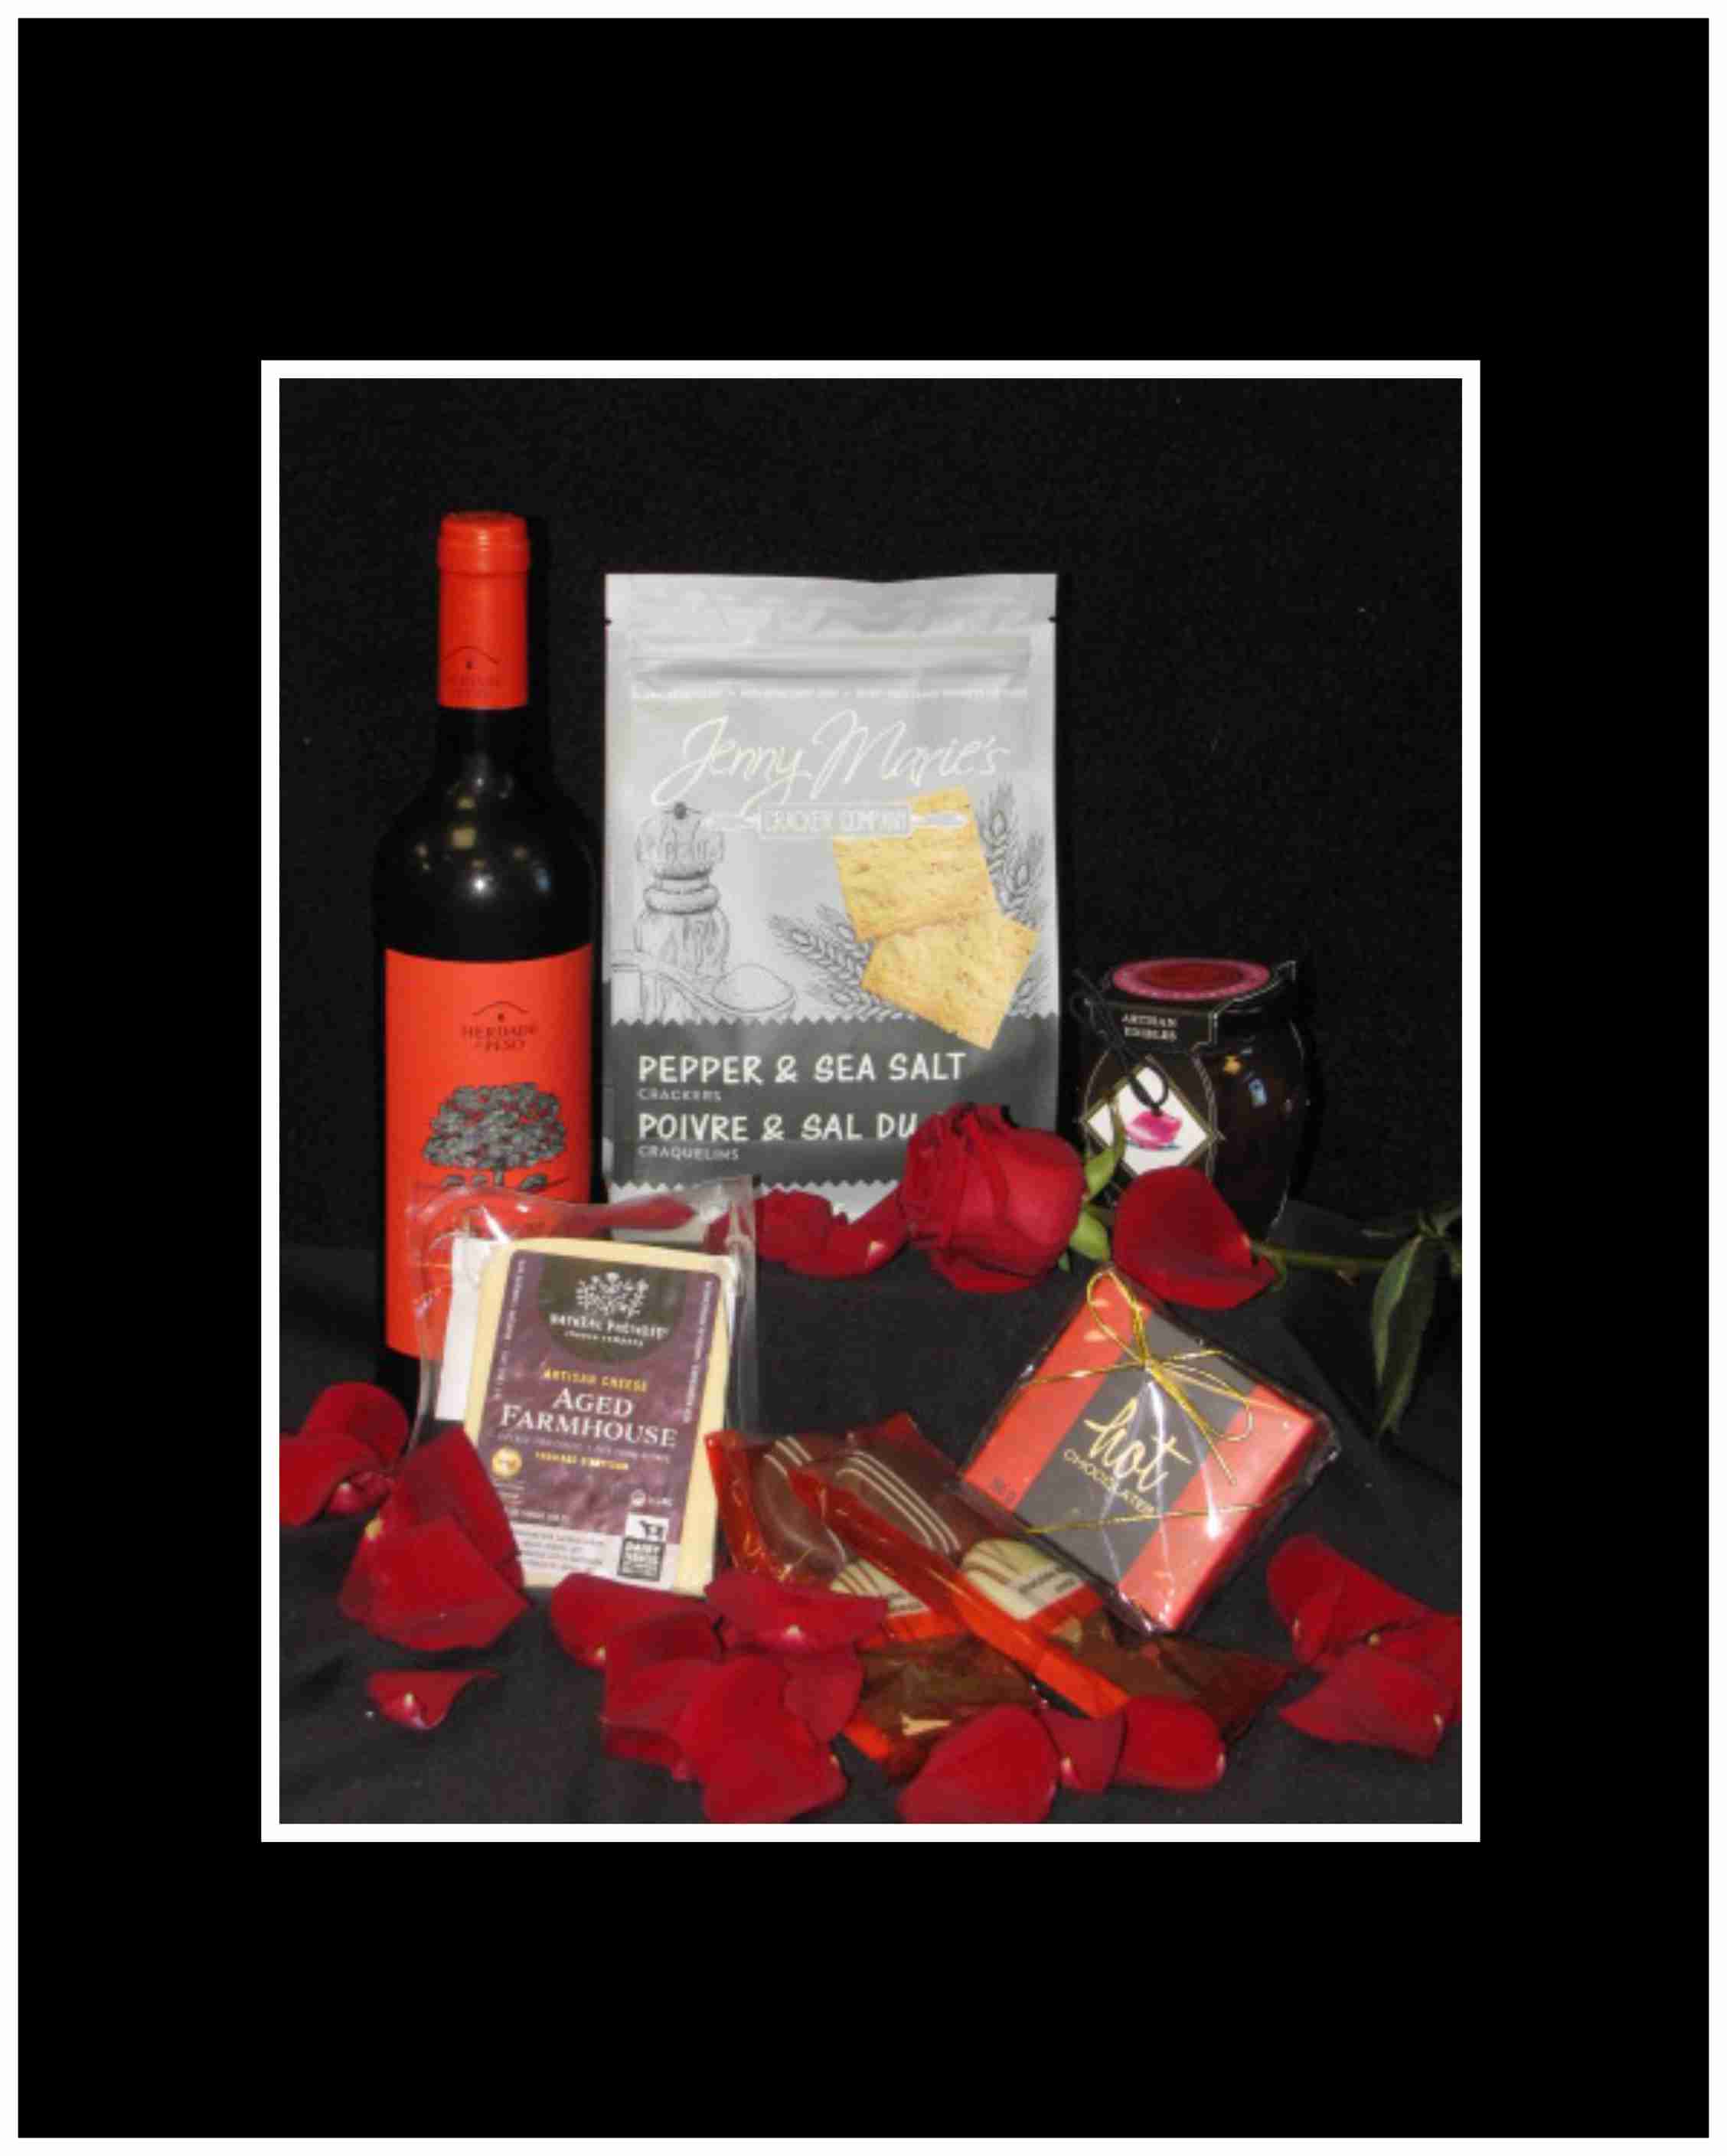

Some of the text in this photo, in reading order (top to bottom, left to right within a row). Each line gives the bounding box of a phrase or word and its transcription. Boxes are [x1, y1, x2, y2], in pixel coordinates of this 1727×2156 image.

[650, 709, 1010, 817] Jenny Marie's
[638, 1052, 967, 1085] PEPPER & SEA SALT
[638, 1088, 722, 1101] CRACKERS
[638, 1112, 919, 1142] POIVRE & SAL DU
[637, 1145, 740, 1161] CRAQUELINS
[543, 1368, 597, 1384] ARTISAN
[552, 1387, 634, 1417] AGED
[499, 1403, 680, 1447] FARMHOUSE
[1083, 1396, 1193, 1492] hot
